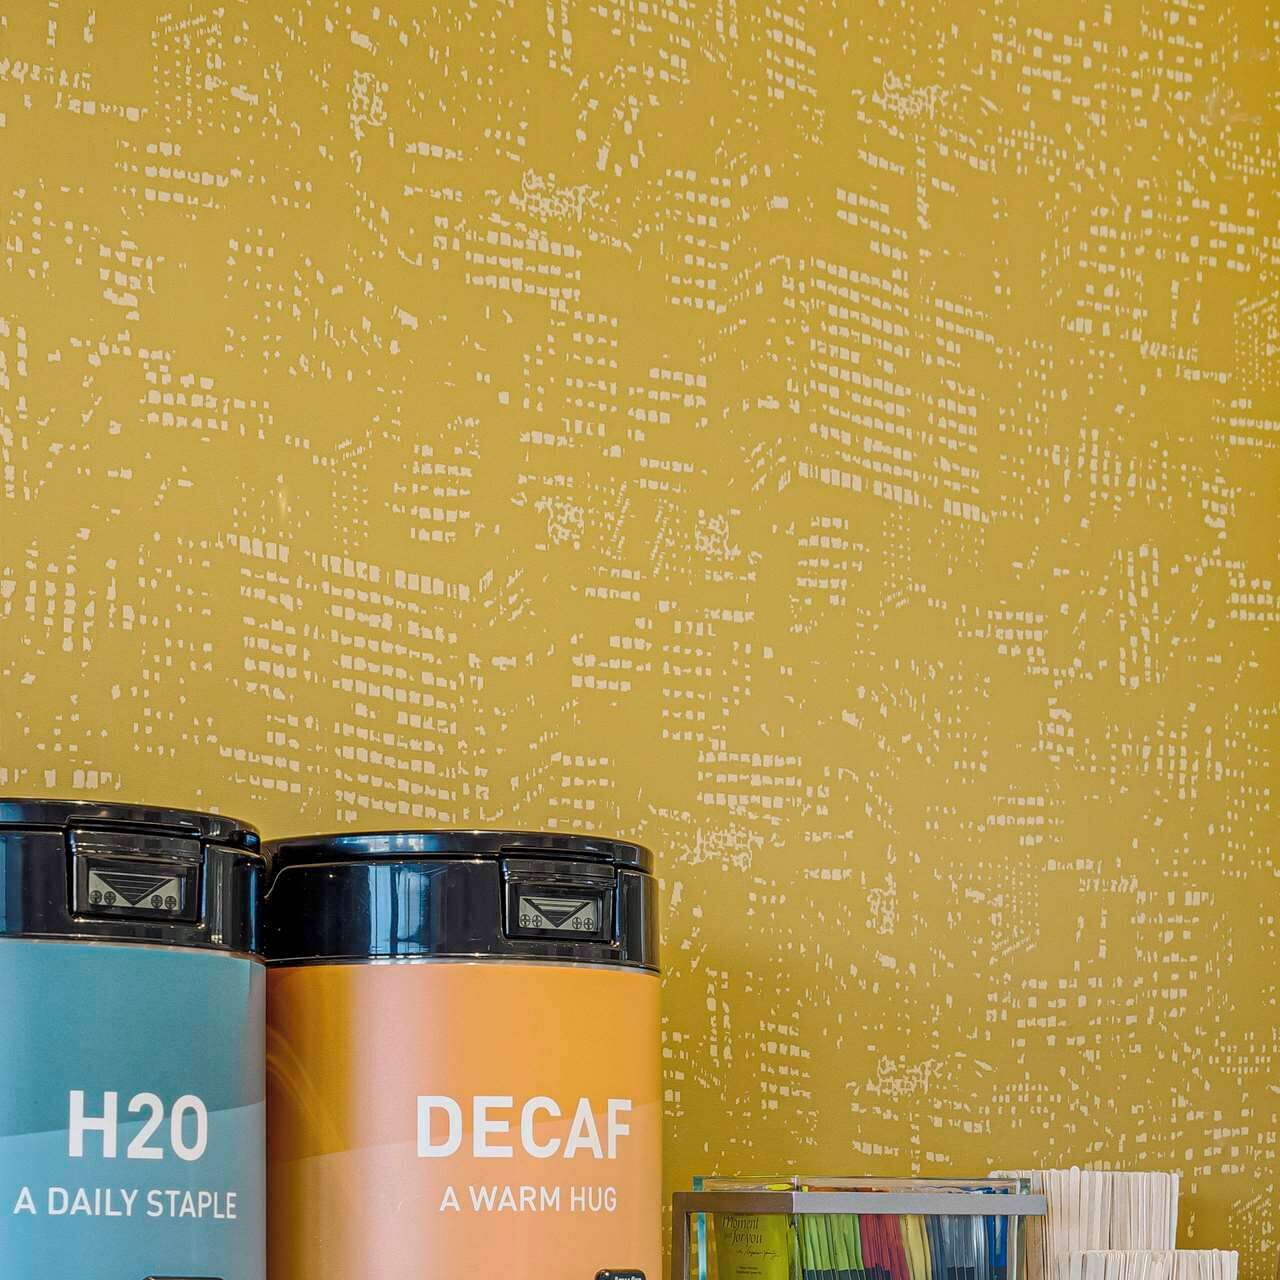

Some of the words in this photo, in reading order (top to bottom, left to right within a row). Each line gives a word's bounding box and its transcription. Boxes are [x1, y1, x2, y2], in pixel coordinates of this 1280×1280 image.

[416, 1095, 632, 1160] DECAF
[13, 1187, 37, 1215] A
[48, 1187, 139, 1217] DAILY
[146, 1189, 237, 1219] STAPLE
[439, 1185, 461, 1212] A
[469, 1185, 560, 1212] WARM
[570, 1186, 617, 1212] HUG
